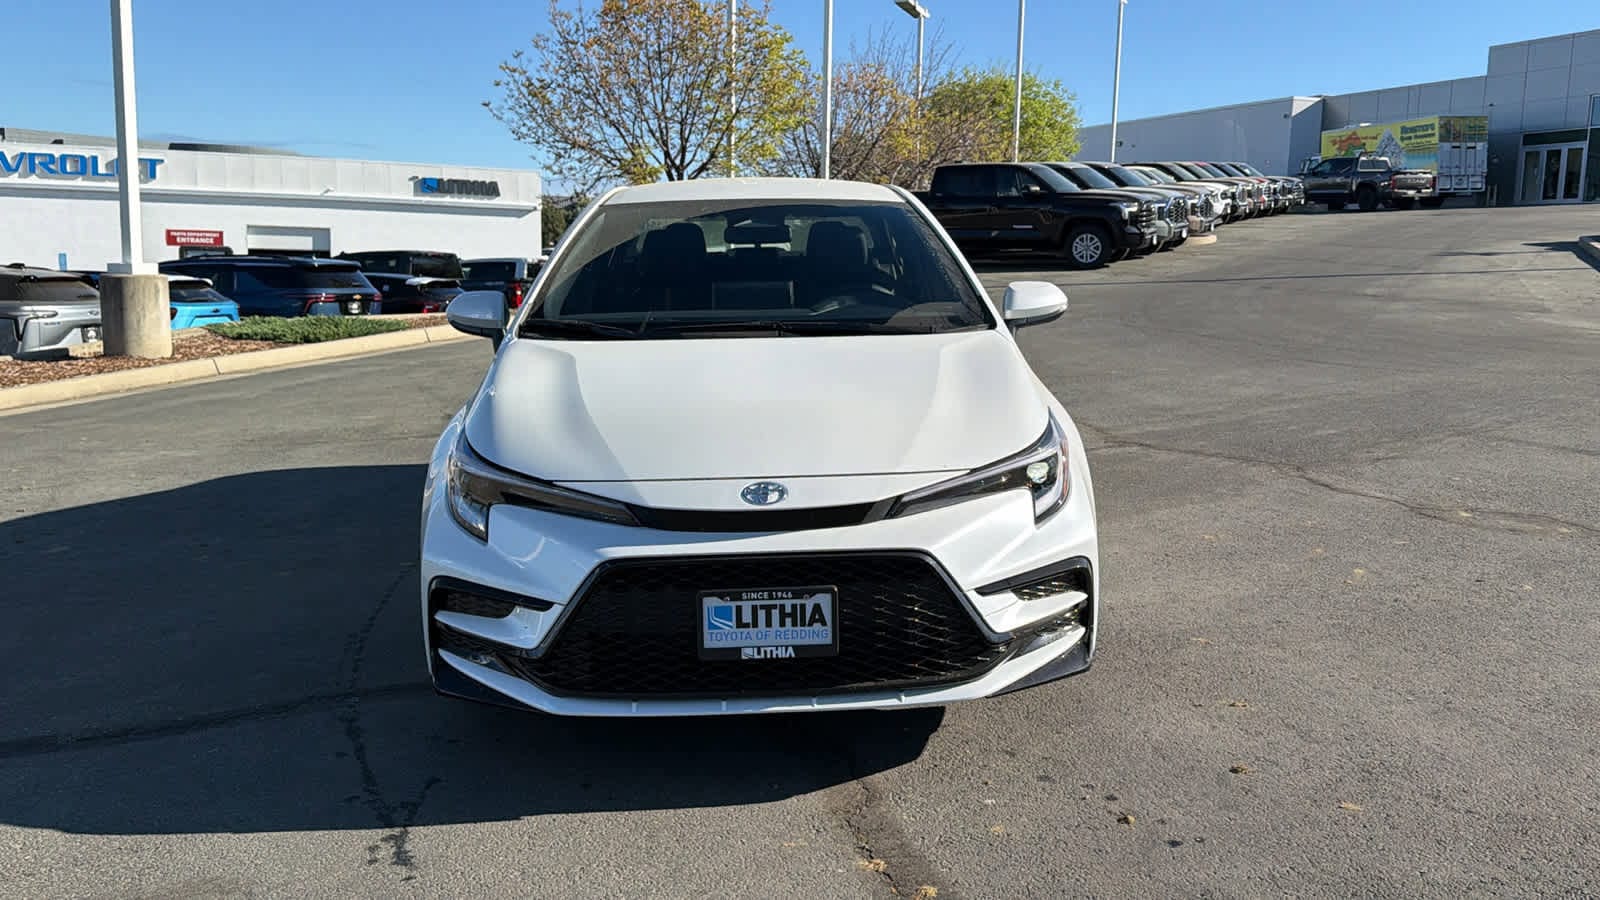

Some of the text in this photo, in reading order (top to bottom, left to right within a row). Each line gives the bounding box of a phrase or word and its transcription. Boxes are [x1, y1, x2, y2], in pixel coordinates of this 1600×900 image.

[439, 178, 501, 197] LITHIA
[741, 591, 793, 600] SINCE 1946
[735, 603, 828, 629] LITHIA
[709, 628, 829, 642] TOYOTA OF REDDING
[754, 646, 796, 659] LITHIA
